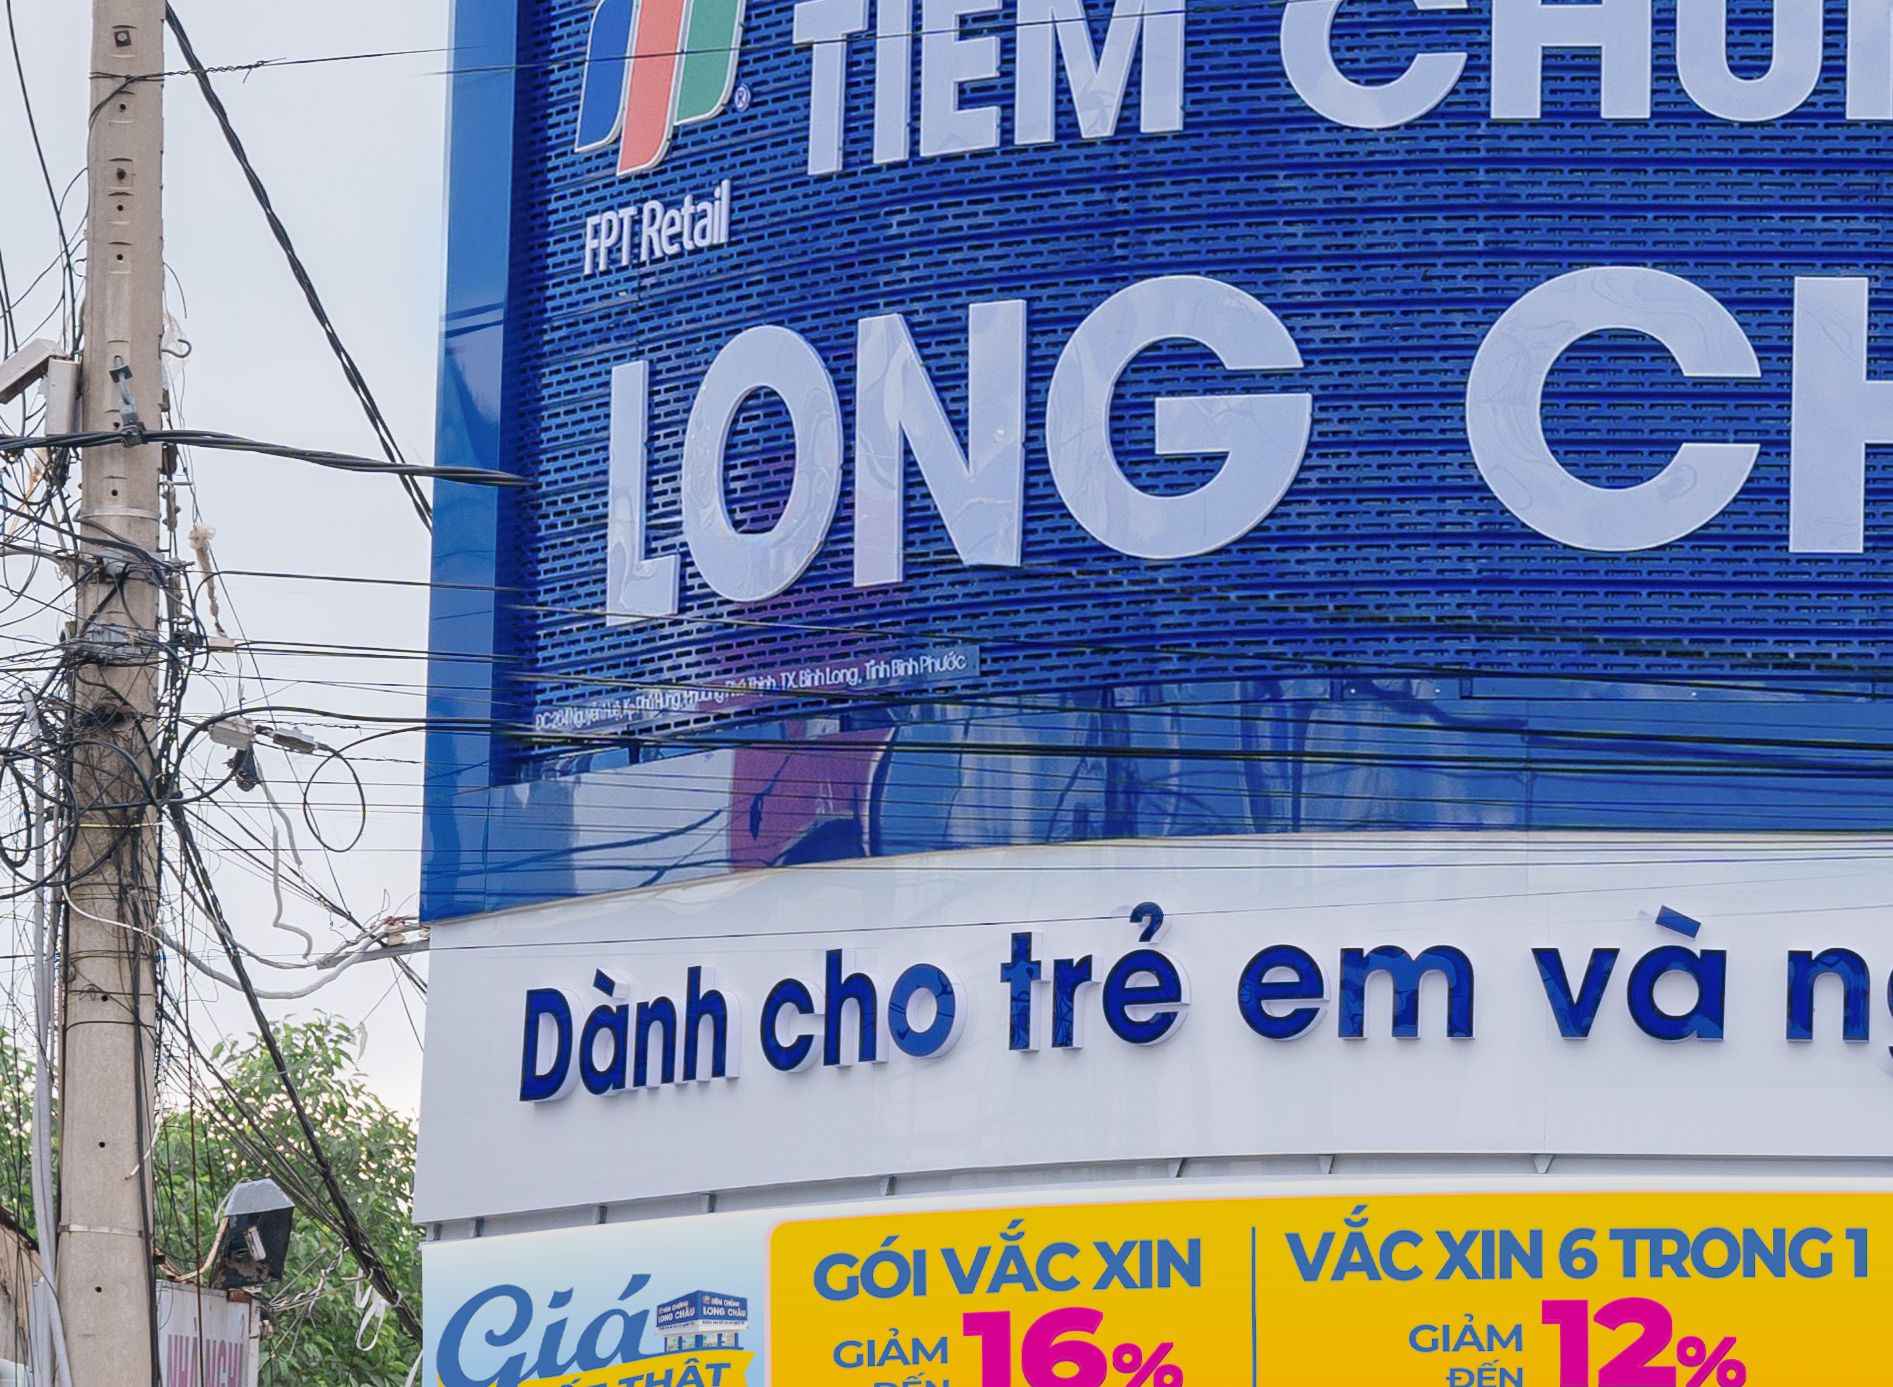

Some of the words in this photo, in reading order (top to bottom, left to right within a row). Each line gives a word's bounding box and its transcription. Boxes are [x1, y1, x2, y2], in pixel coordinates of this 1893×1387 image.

[641, 179, 731, 263] Retail
[605, 275, 1312, 626] LONG
[519, 966, 730, 1104] Dành
[760, 946, 961, 1074] cho
[999, 900, 1187, 1054] trẻ
[1239, 943, 1477, 1040] em
[1532, 904, 1728, 1041] và
[811, 1232, 929, 1304] GÓI
[939, 1217, 1080, 1295] VẮC
[1093, 1235, 1203, 1292] XIN
[1285, 1203, 1425, 1284] VẮC
[1434, 1228, 1545, 1282] XIN
[1558, 1225, 1600, 1282] 6
[1609, 1225, 1835, 1282] TRONG
[832, 1331, 950, 1370] GIẢM
[1408, 1321, 1524, 1355] GIẢM
